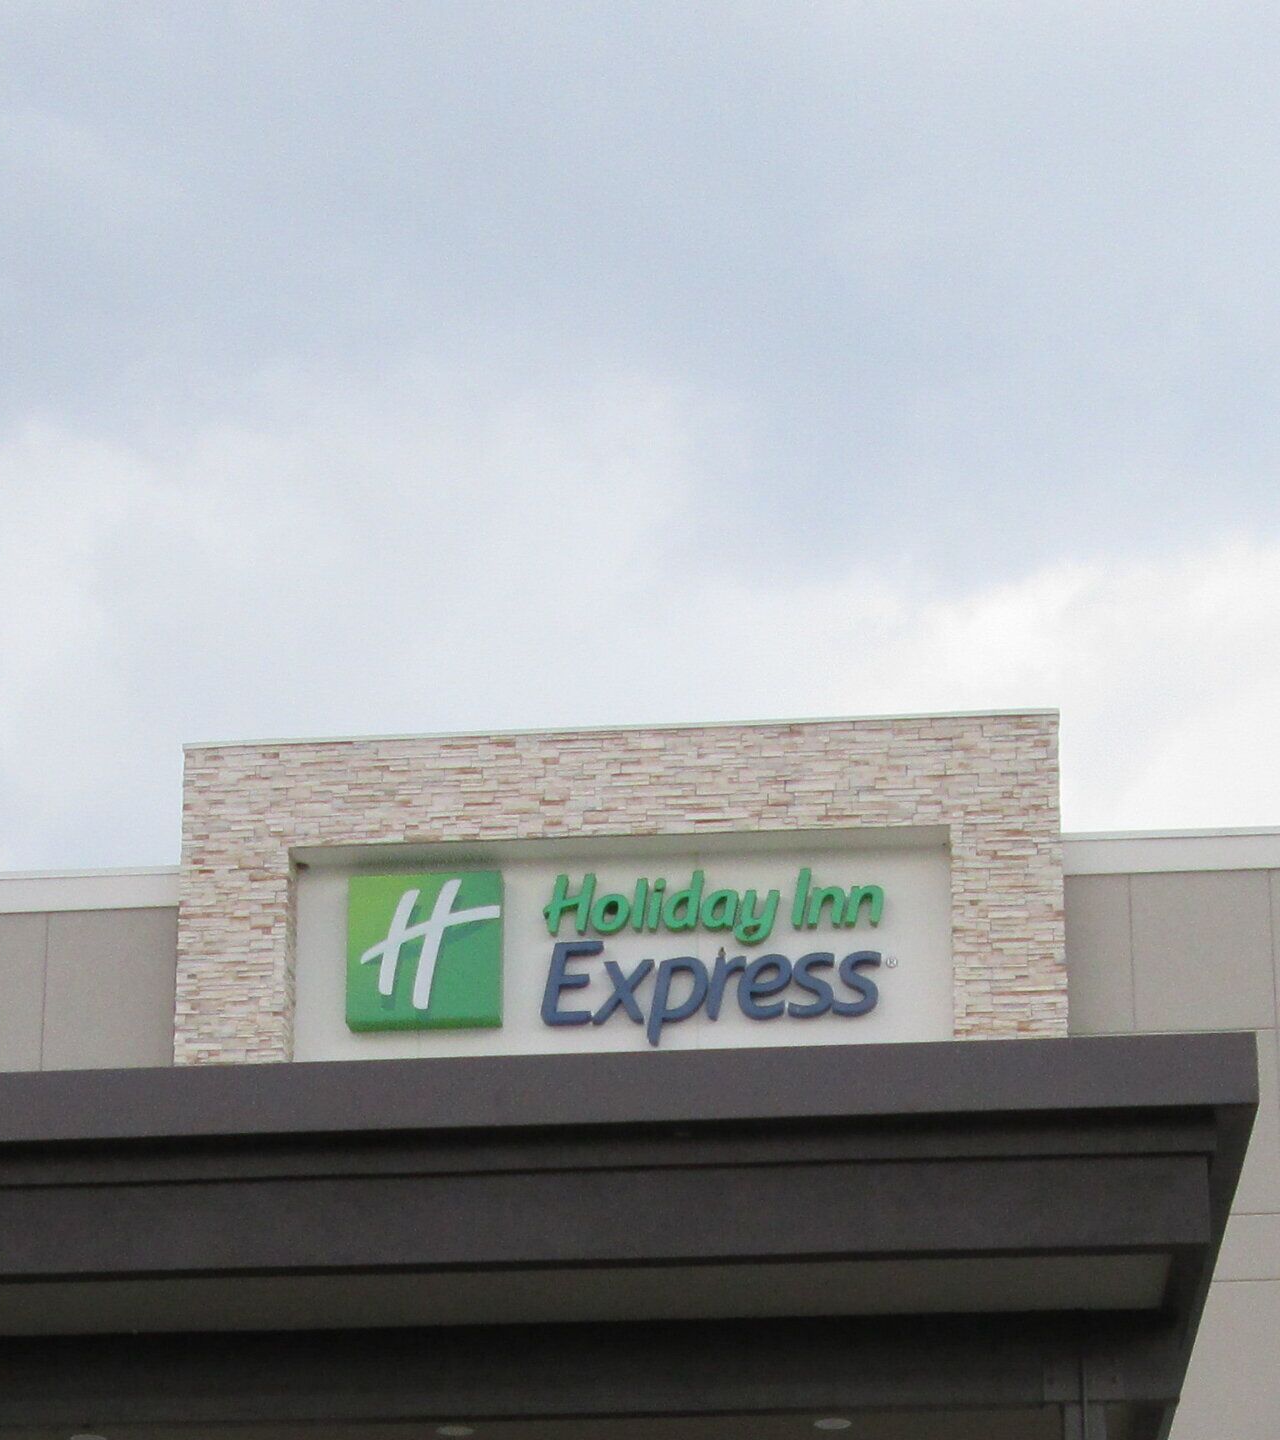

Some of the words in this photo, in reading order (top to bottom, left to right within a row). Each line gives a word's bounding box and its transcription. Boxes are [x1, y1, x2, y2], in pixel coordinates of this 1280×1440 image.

[542, 869, 780, 945] Holiday
[792, 867, 885, 929] Inn
[539, 940, 882, 1047] Express
